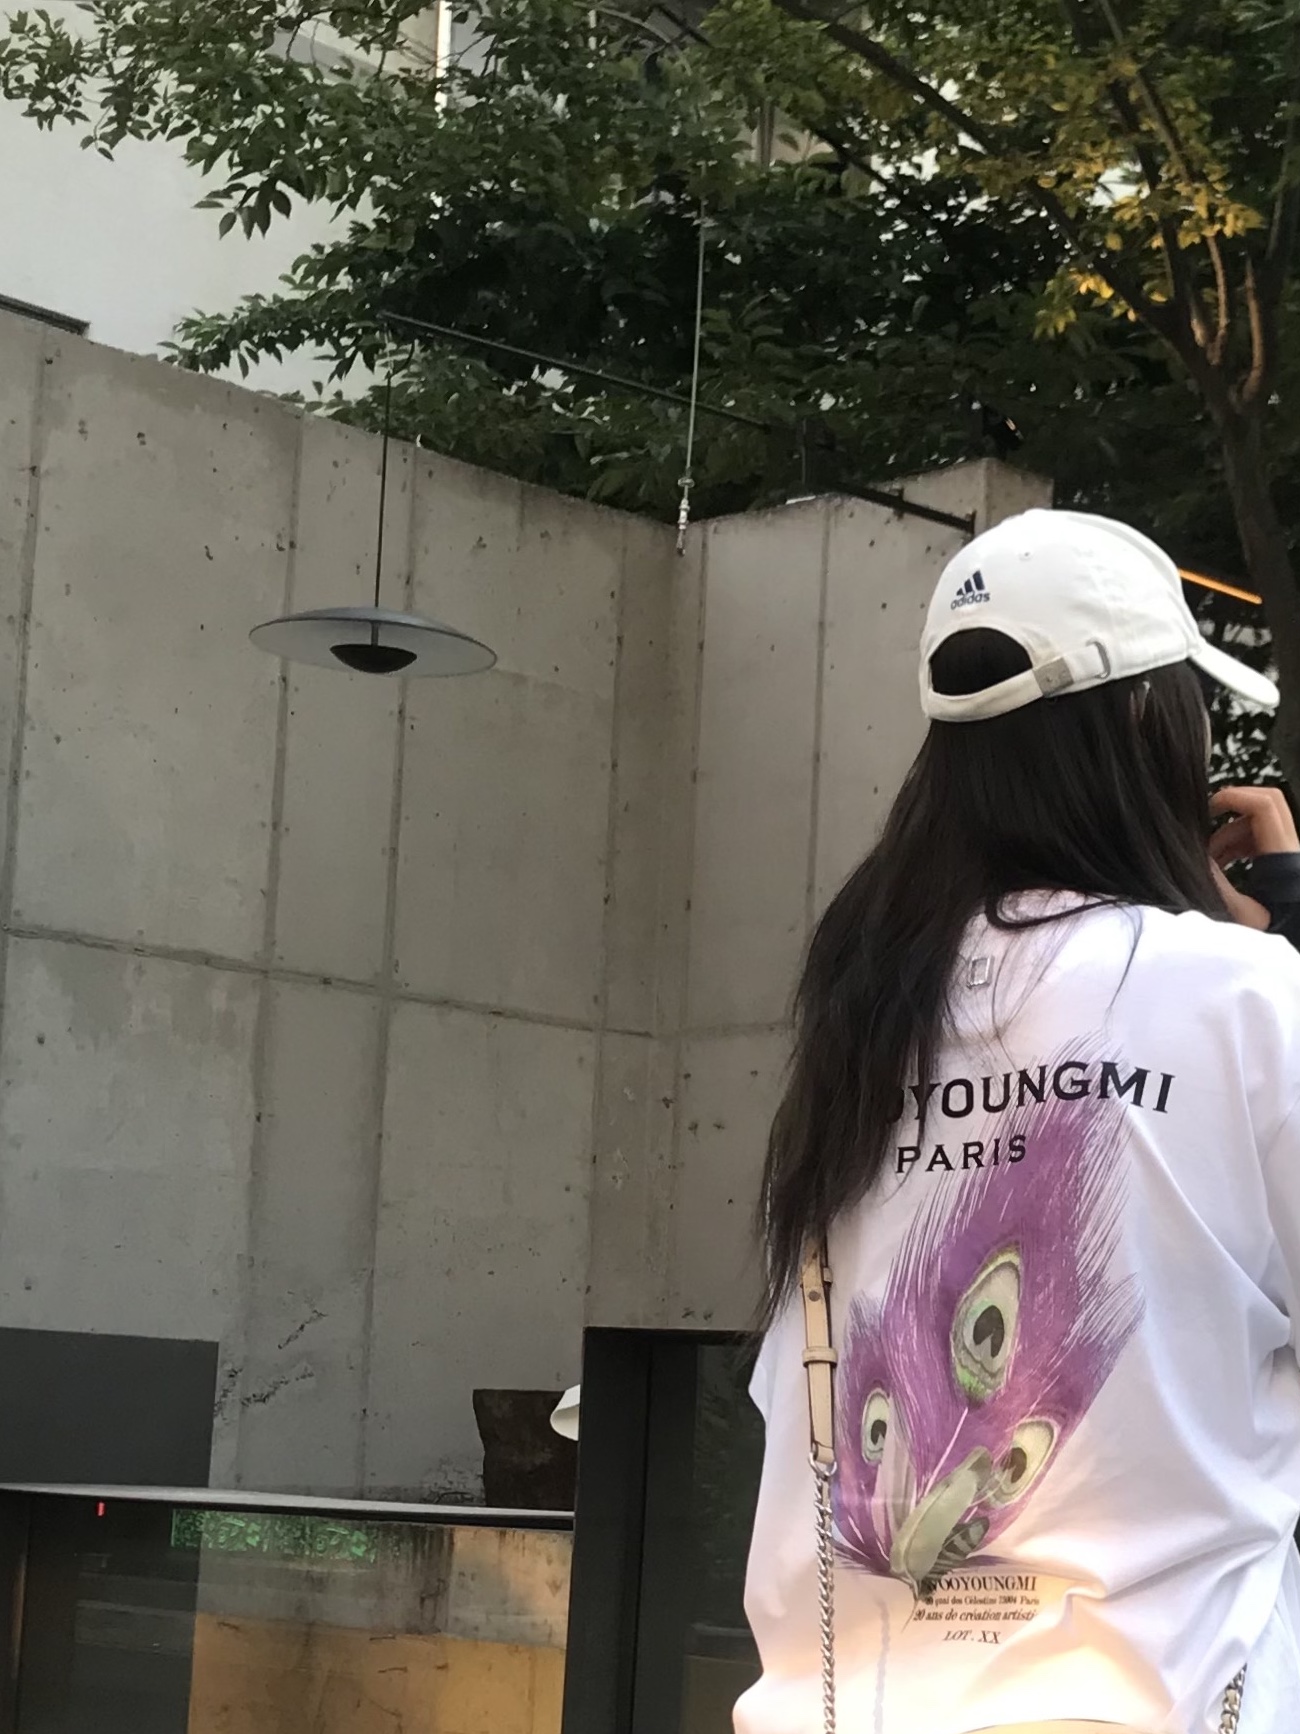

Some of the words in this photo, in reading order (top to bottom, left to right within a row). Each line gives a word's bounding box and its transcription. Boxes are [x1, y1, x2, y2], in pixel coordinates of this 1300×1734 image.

[950, 590, 990, 610] adidas
[896, 1134, 1027, 1174] PARIS
[926, 1611, 943, 1621] ans
[945, 1608, 958, 1621] de
[1001, 1608, 1038, 1621] artisti
[977, 1630, 1002, 1645] XX
